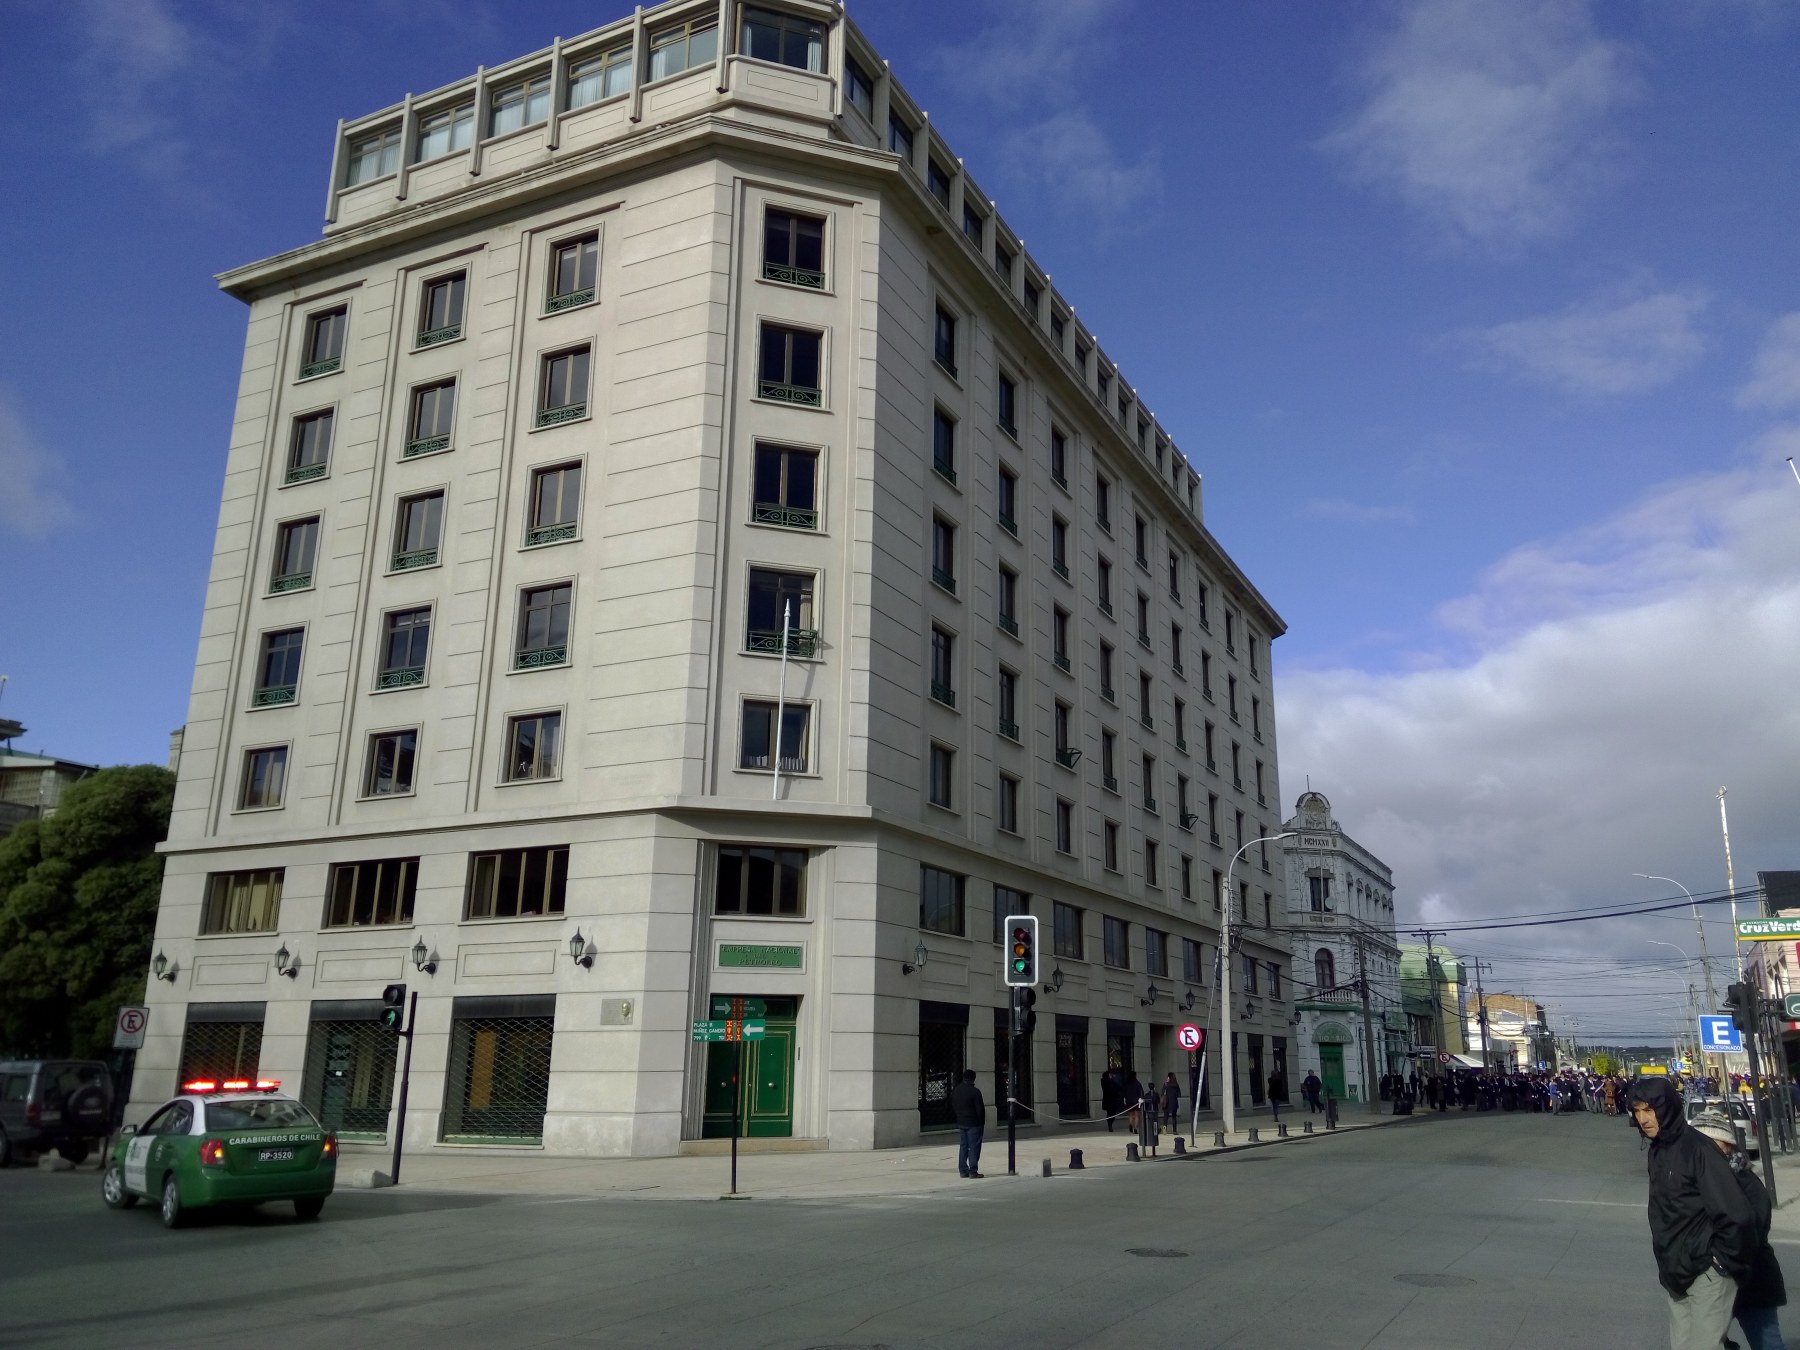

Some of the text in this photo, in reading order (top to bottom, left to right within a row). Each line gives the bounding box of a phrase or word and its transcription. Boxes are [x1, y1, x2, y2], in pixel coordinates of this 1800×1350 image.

[1711, 1021, 1731, 1045] E
[229, 1133, 320, 1145] CARABINEROS DE CHILE
